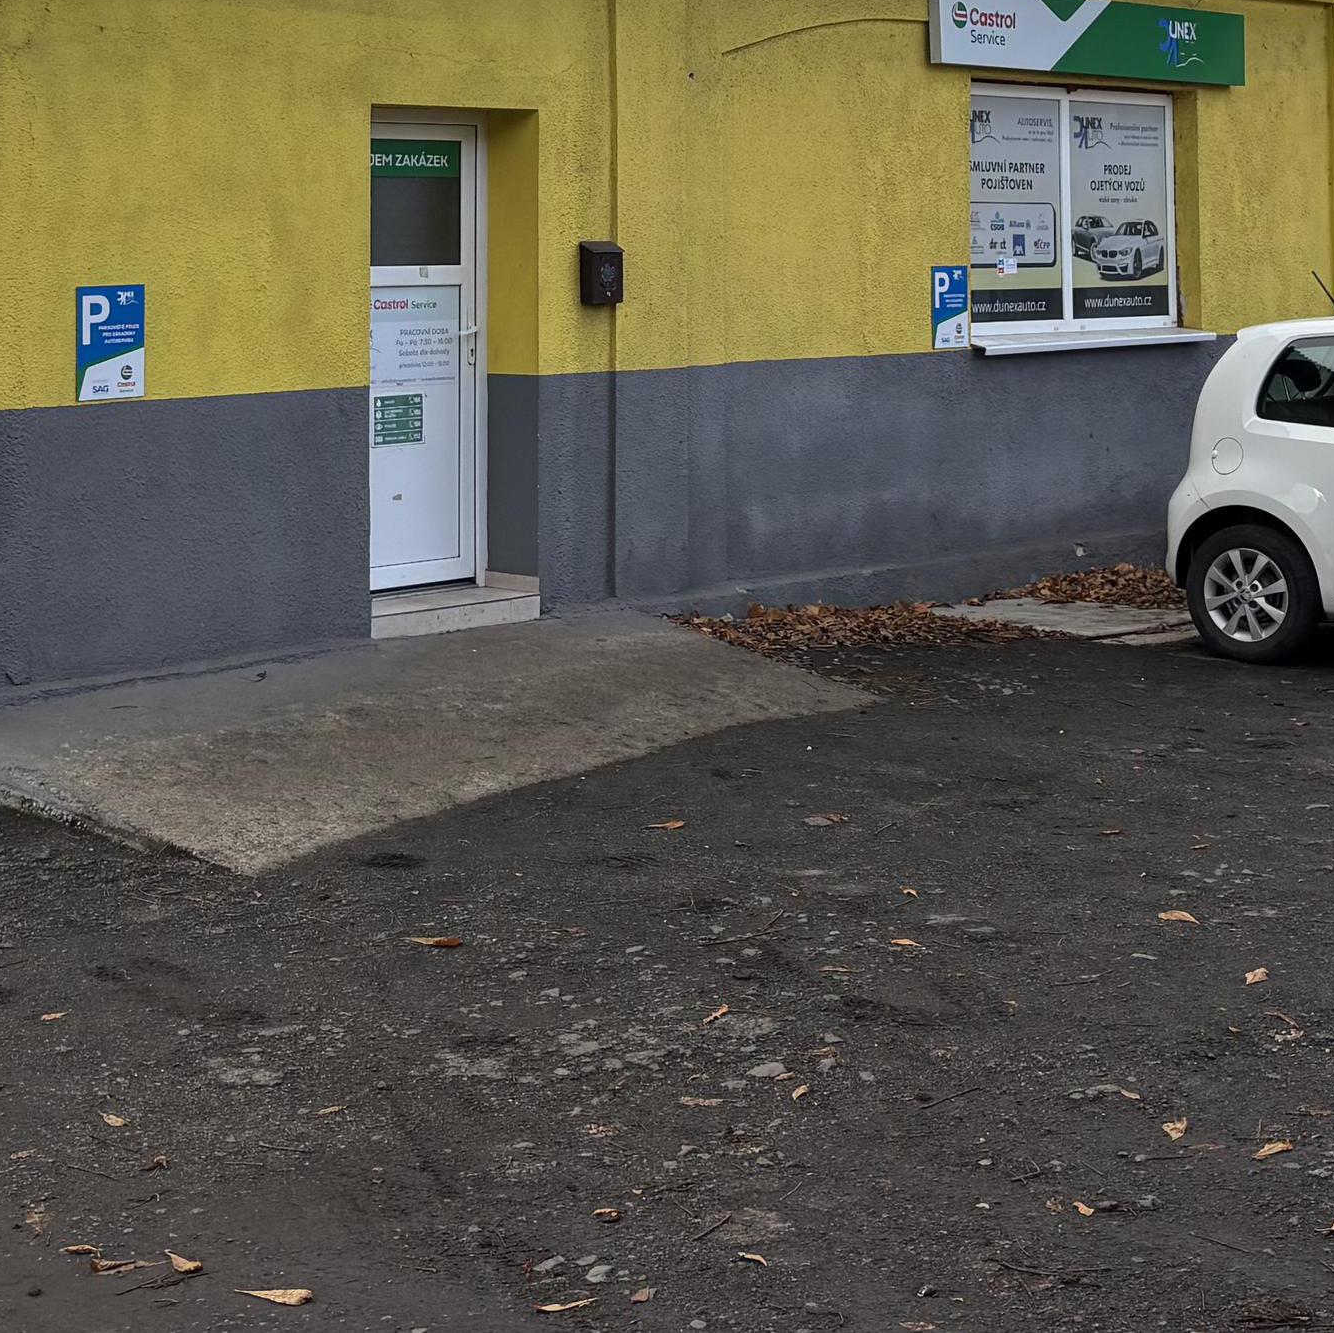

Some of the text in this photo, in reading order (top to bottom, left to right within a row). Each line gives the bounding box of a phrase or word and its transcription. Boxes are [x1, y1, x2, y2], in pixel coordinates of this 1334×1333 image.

[969, 7, 1016, 29] Castrol
[970, 29, 1006, 46] Service
[395, 151, 449, 168] ZAKÁZEK
[1009, 162, 1045, 174] PARTNER
[1103, 164, 1132, 176] PRODEJ
[1090, 178, 1145, 192] OJETÝCH VOZŮ
[934, 271, 950, 308] P
[373, 299, 438, 310] Castrol Service
[971, 299, 1047, 314] www.dunexauto.cz
[1084, 293, 1153, 308] www.dunexauto.cz
[82, 294, 110, 346] P
